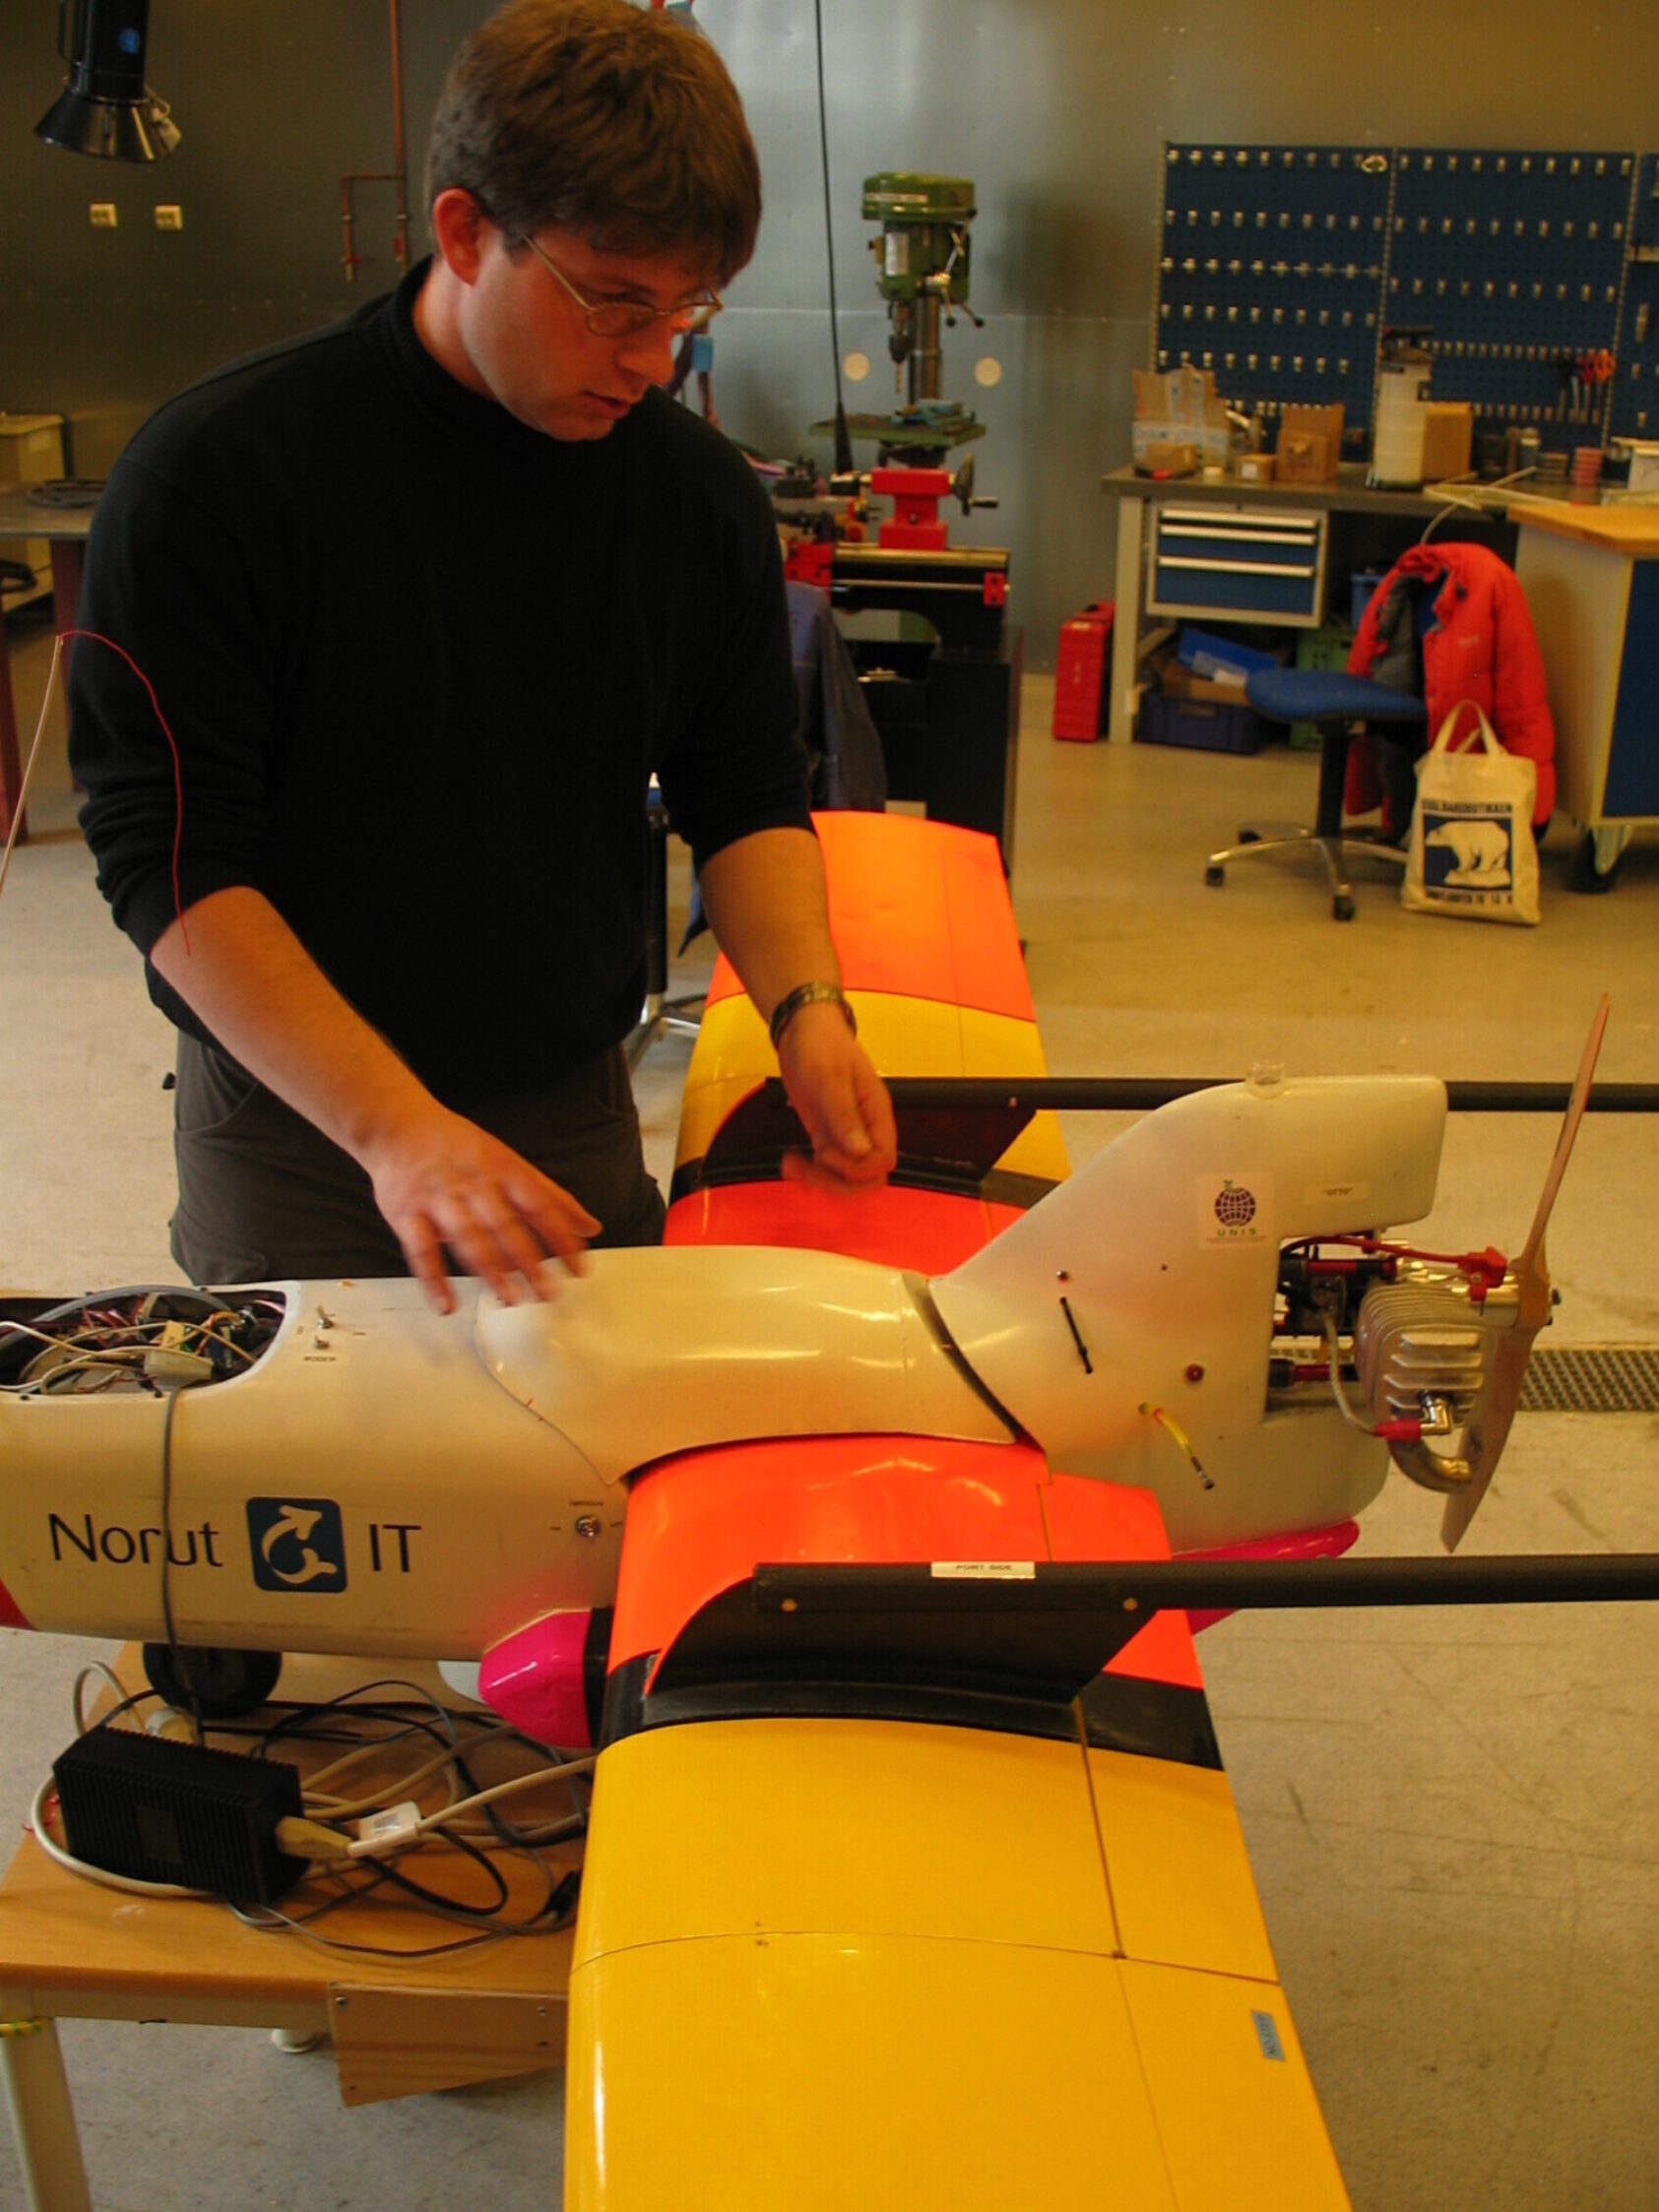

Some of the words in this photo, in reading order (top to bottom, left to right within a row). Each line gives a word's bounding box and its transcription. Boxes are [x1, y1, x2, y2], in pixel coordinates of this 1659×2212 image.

[1217, 1228, 1257, 1236] UNIS
[47, 1512, 223, 1567] Norut
[368, 1523, 422, 1573] IT
